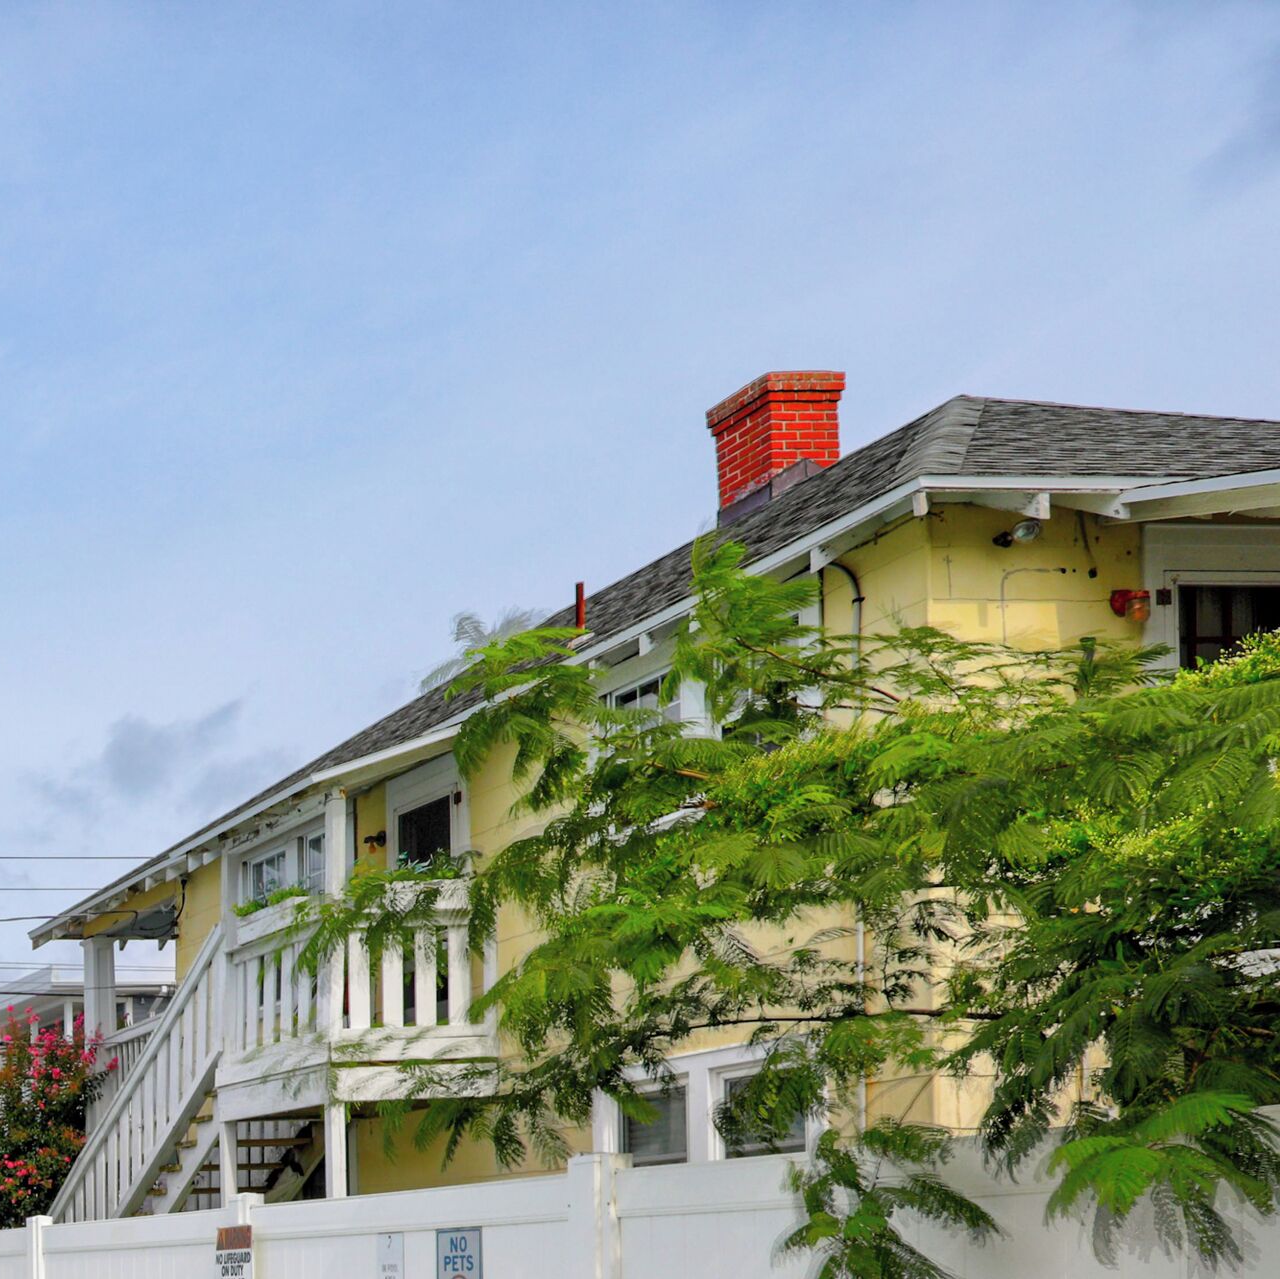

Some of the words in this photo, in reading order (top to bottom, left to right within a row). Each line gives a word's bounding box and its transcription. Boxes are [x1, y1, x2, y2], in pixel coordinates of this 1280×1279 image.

[450, 1236, 467, 1253] NO
[216, 1253, 223, 1265] NO
[224, 1251, 251, 1265] LIFEGUARD
[444, 1255, 474, 1272] PETS
[222, 1265, 229, 1277] ON
[230, 1264, 244, 1276] DUTY
